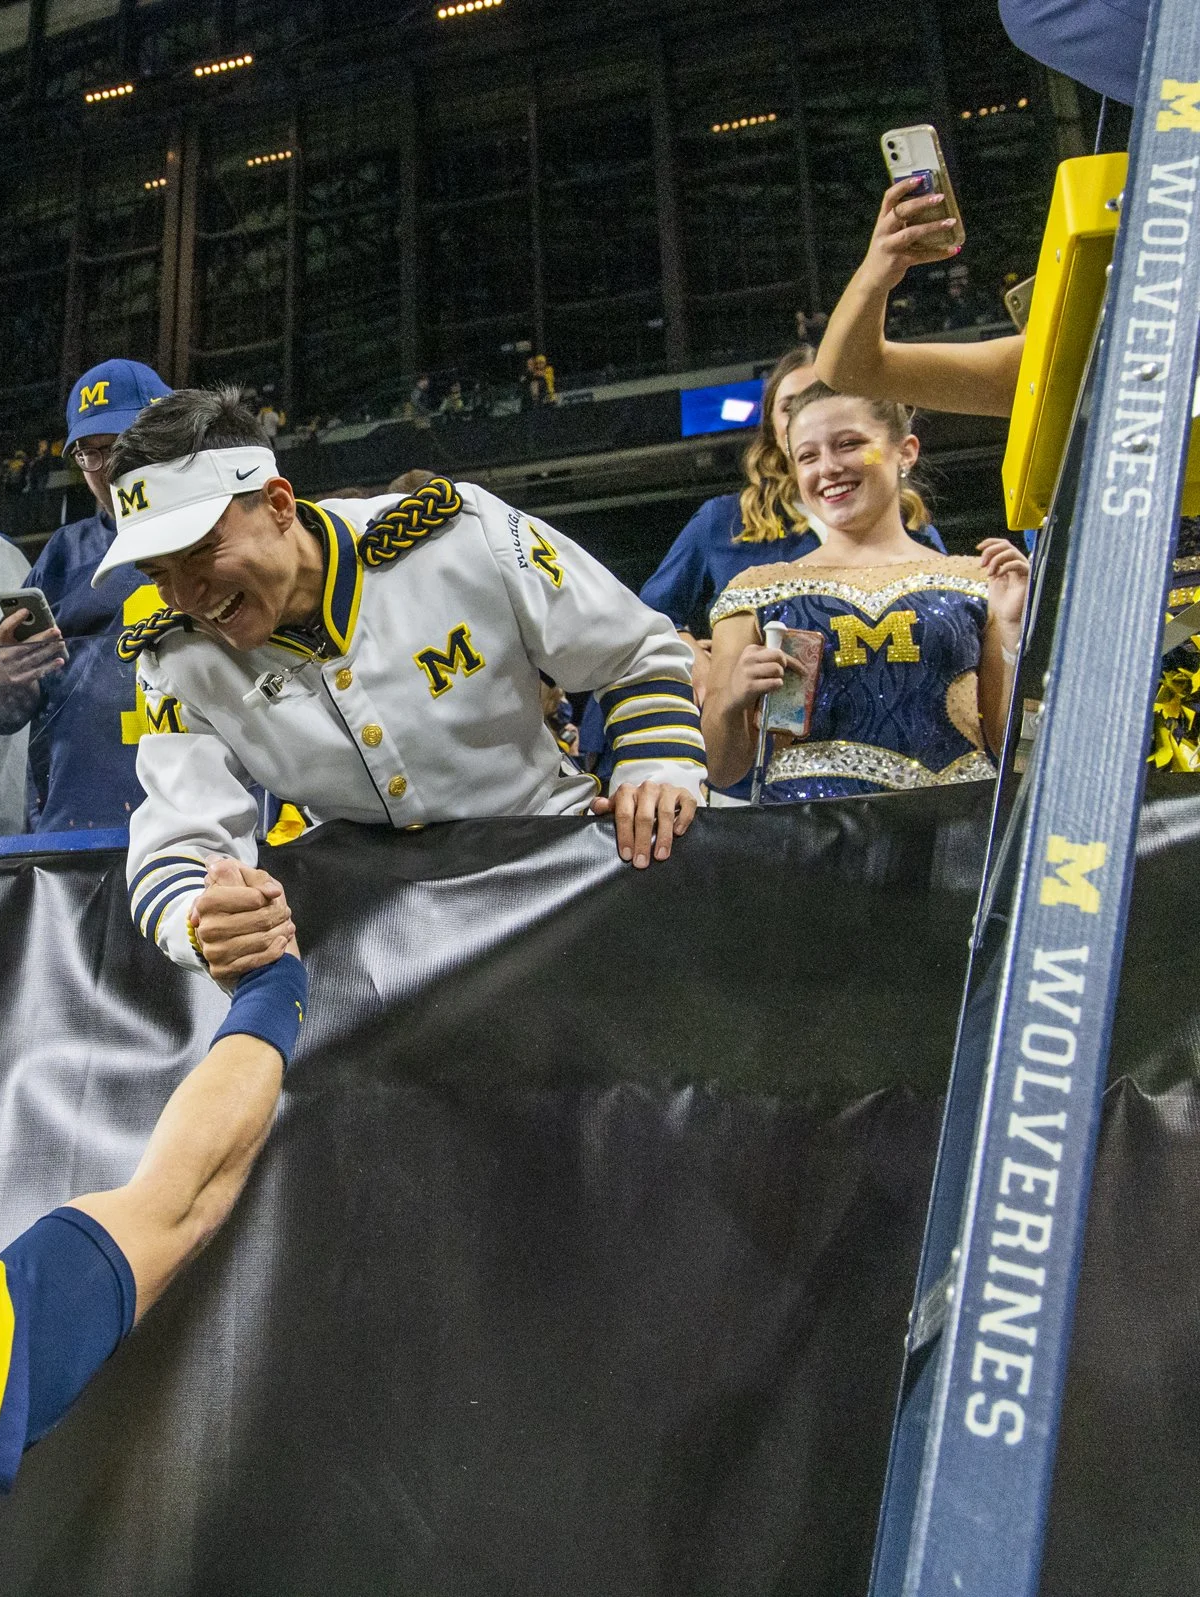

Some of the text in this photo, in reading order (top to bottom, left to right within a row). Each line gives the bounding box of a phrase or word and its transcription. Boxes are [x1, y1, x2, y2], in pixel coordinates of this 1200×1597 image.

[1101, 155, 1200, 519] WOLVERINES
[79, 381, 110, 413] M
[116, 479, 151, 518] M
[412, 621, 487, 700] M
[830, 610, 921, 668] M
[964, 834, 1107, 1447] M WOLVERINES
